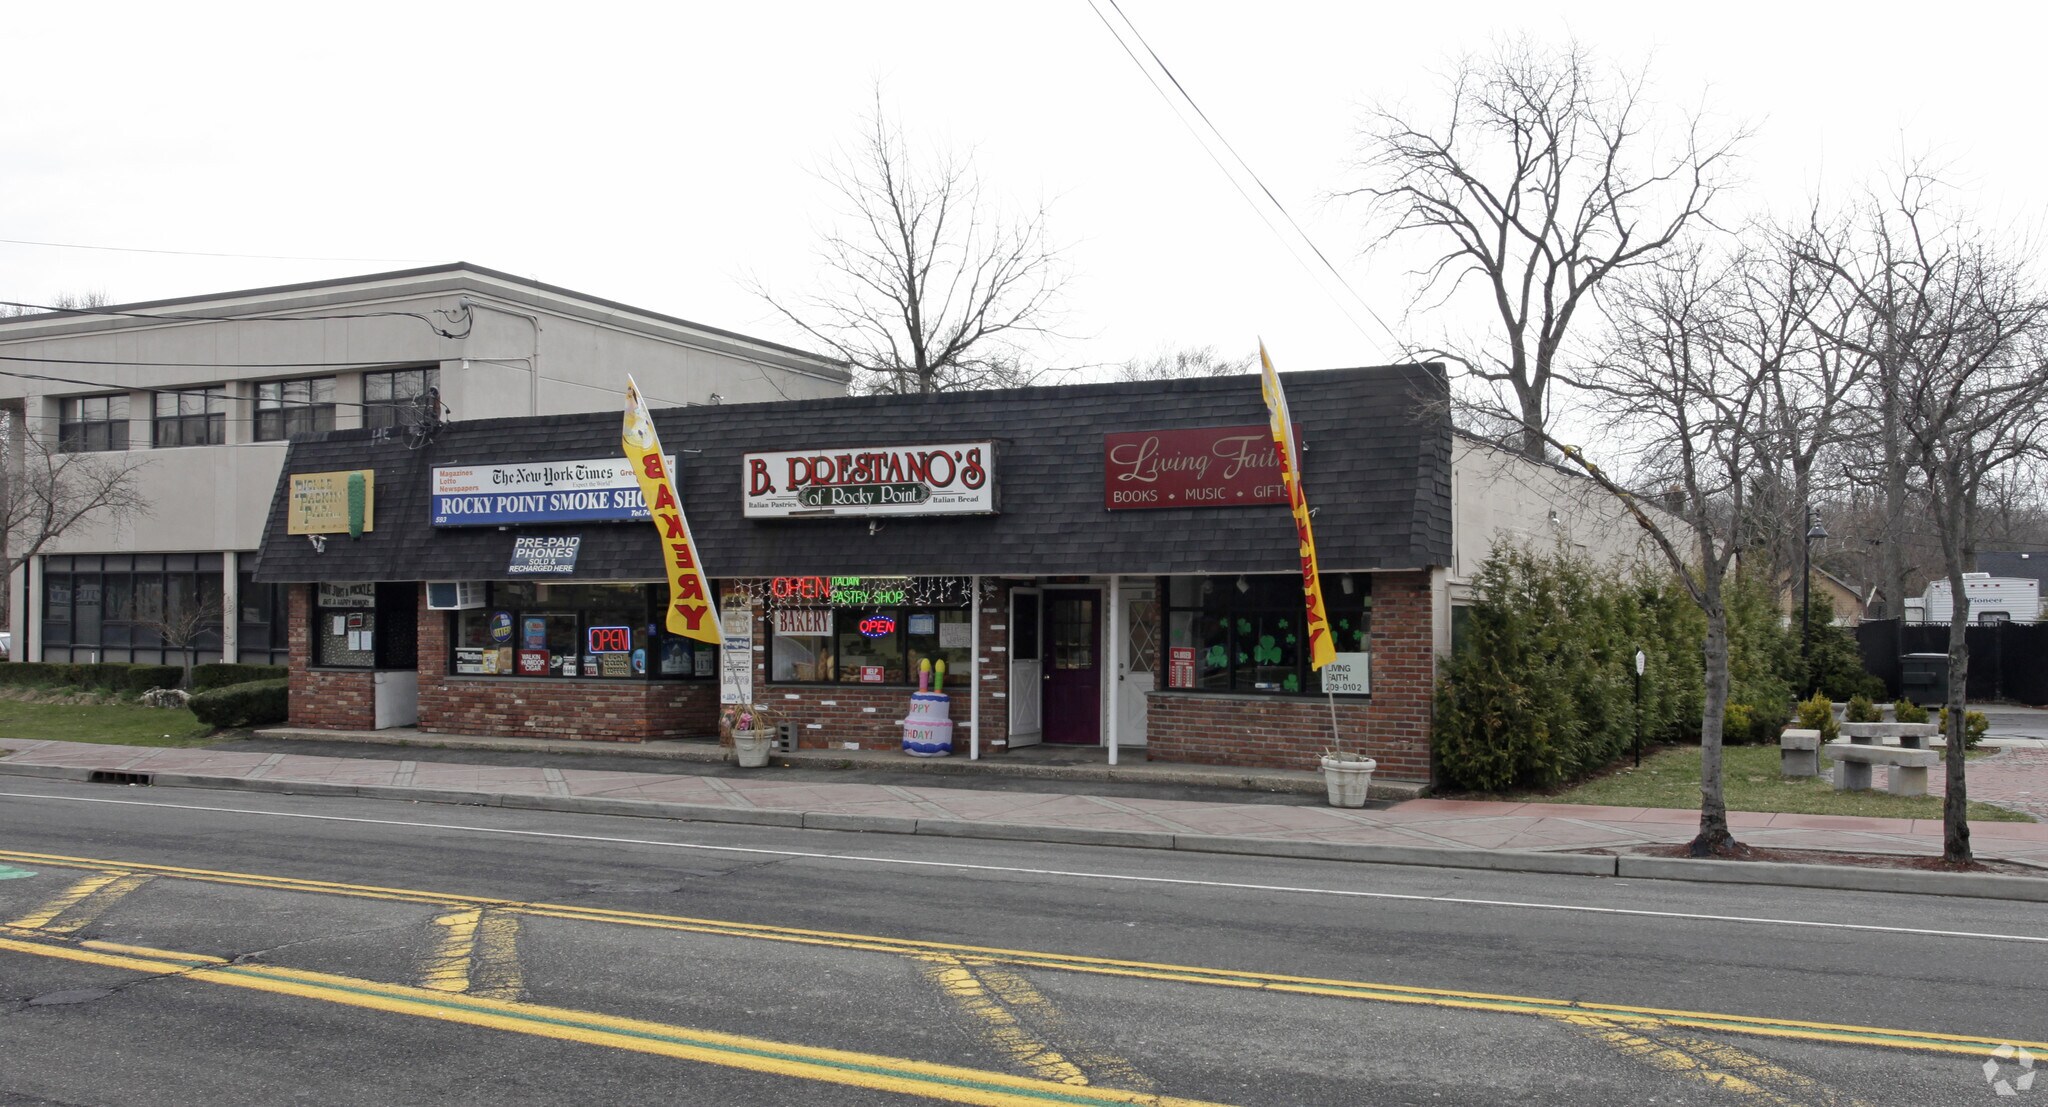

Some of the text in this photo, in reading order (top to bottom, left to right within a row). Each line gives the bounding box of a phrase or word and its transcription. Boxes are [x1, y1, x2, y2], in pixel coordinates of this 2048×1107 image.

[1110, 436, 1212, 482] Living
[439, 470, 473, 478] Magazines
[492, 464, 613, 486] The New York Times
[748, 447, 986, 497] B. PRESTANO'S
[439, 485, 479, 493] Newspapers
[808, 485, 918, 509] of Rocky Point
[1113, 489, 1158, 503] BOOKS
[1185, 487, 1226, 501] MUSIC
[441, 490, 648, 514] ROCKY POINT SMOKE SHO
[515, 536, 580, 548] PRE-PAID
[516, 547, 574, 558] PHONES
[772, 576, 830, 598] OPEN
[831, 590, 904, 604] PASTRY SHOP
[780, 610, 829, 632] BAKERY
[860, 620, 895, 633] OPEN
[591, 629, 628, 651] OPEN
[911, 703, 930, 713] PPY
[904, 729, 933, 740] THDAY!
